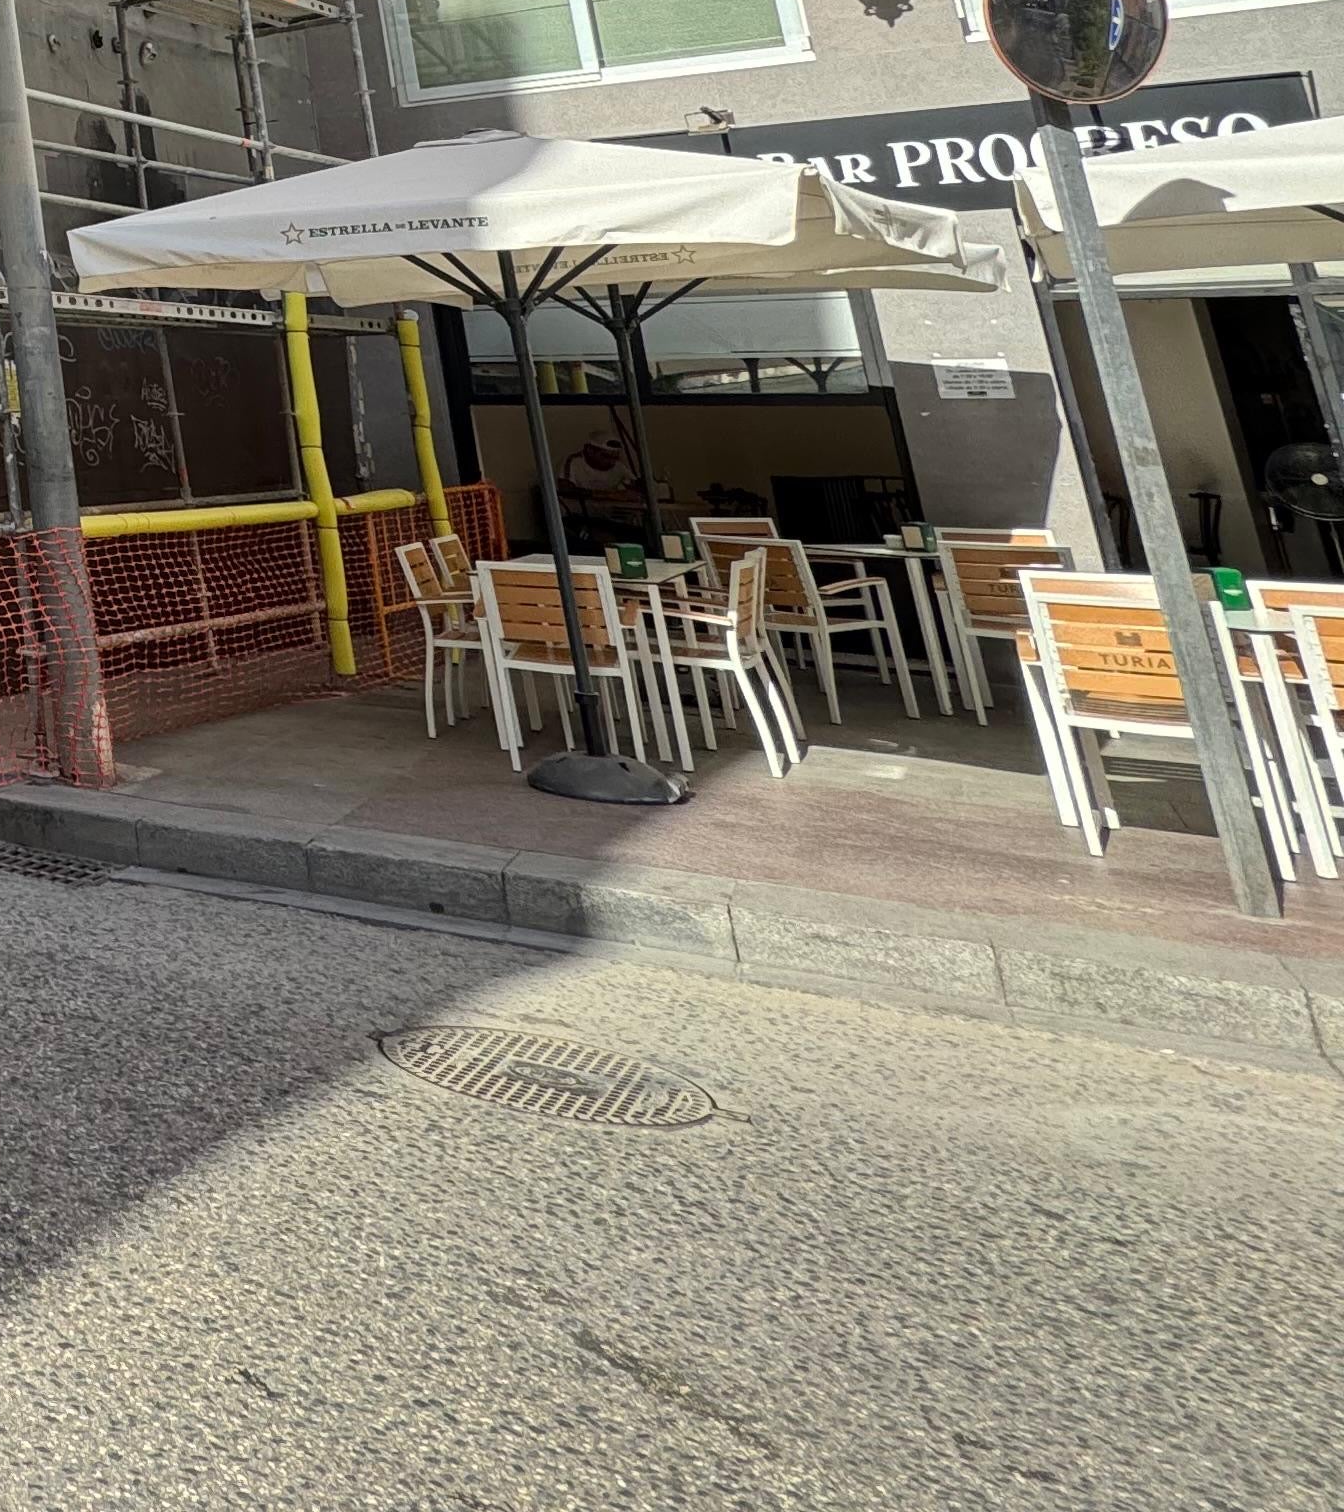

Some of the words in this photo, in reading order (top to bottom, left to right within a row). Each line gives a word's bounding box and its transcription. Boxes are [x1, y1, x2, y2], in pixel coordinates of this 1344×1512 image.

[886, 112, 1270, 188] PRORES
[308, 222, 393, 238] ESTRELLA
[407, 216, 489, 231] LEVANTE
[1098, 652, 1172, 669] TURIA
